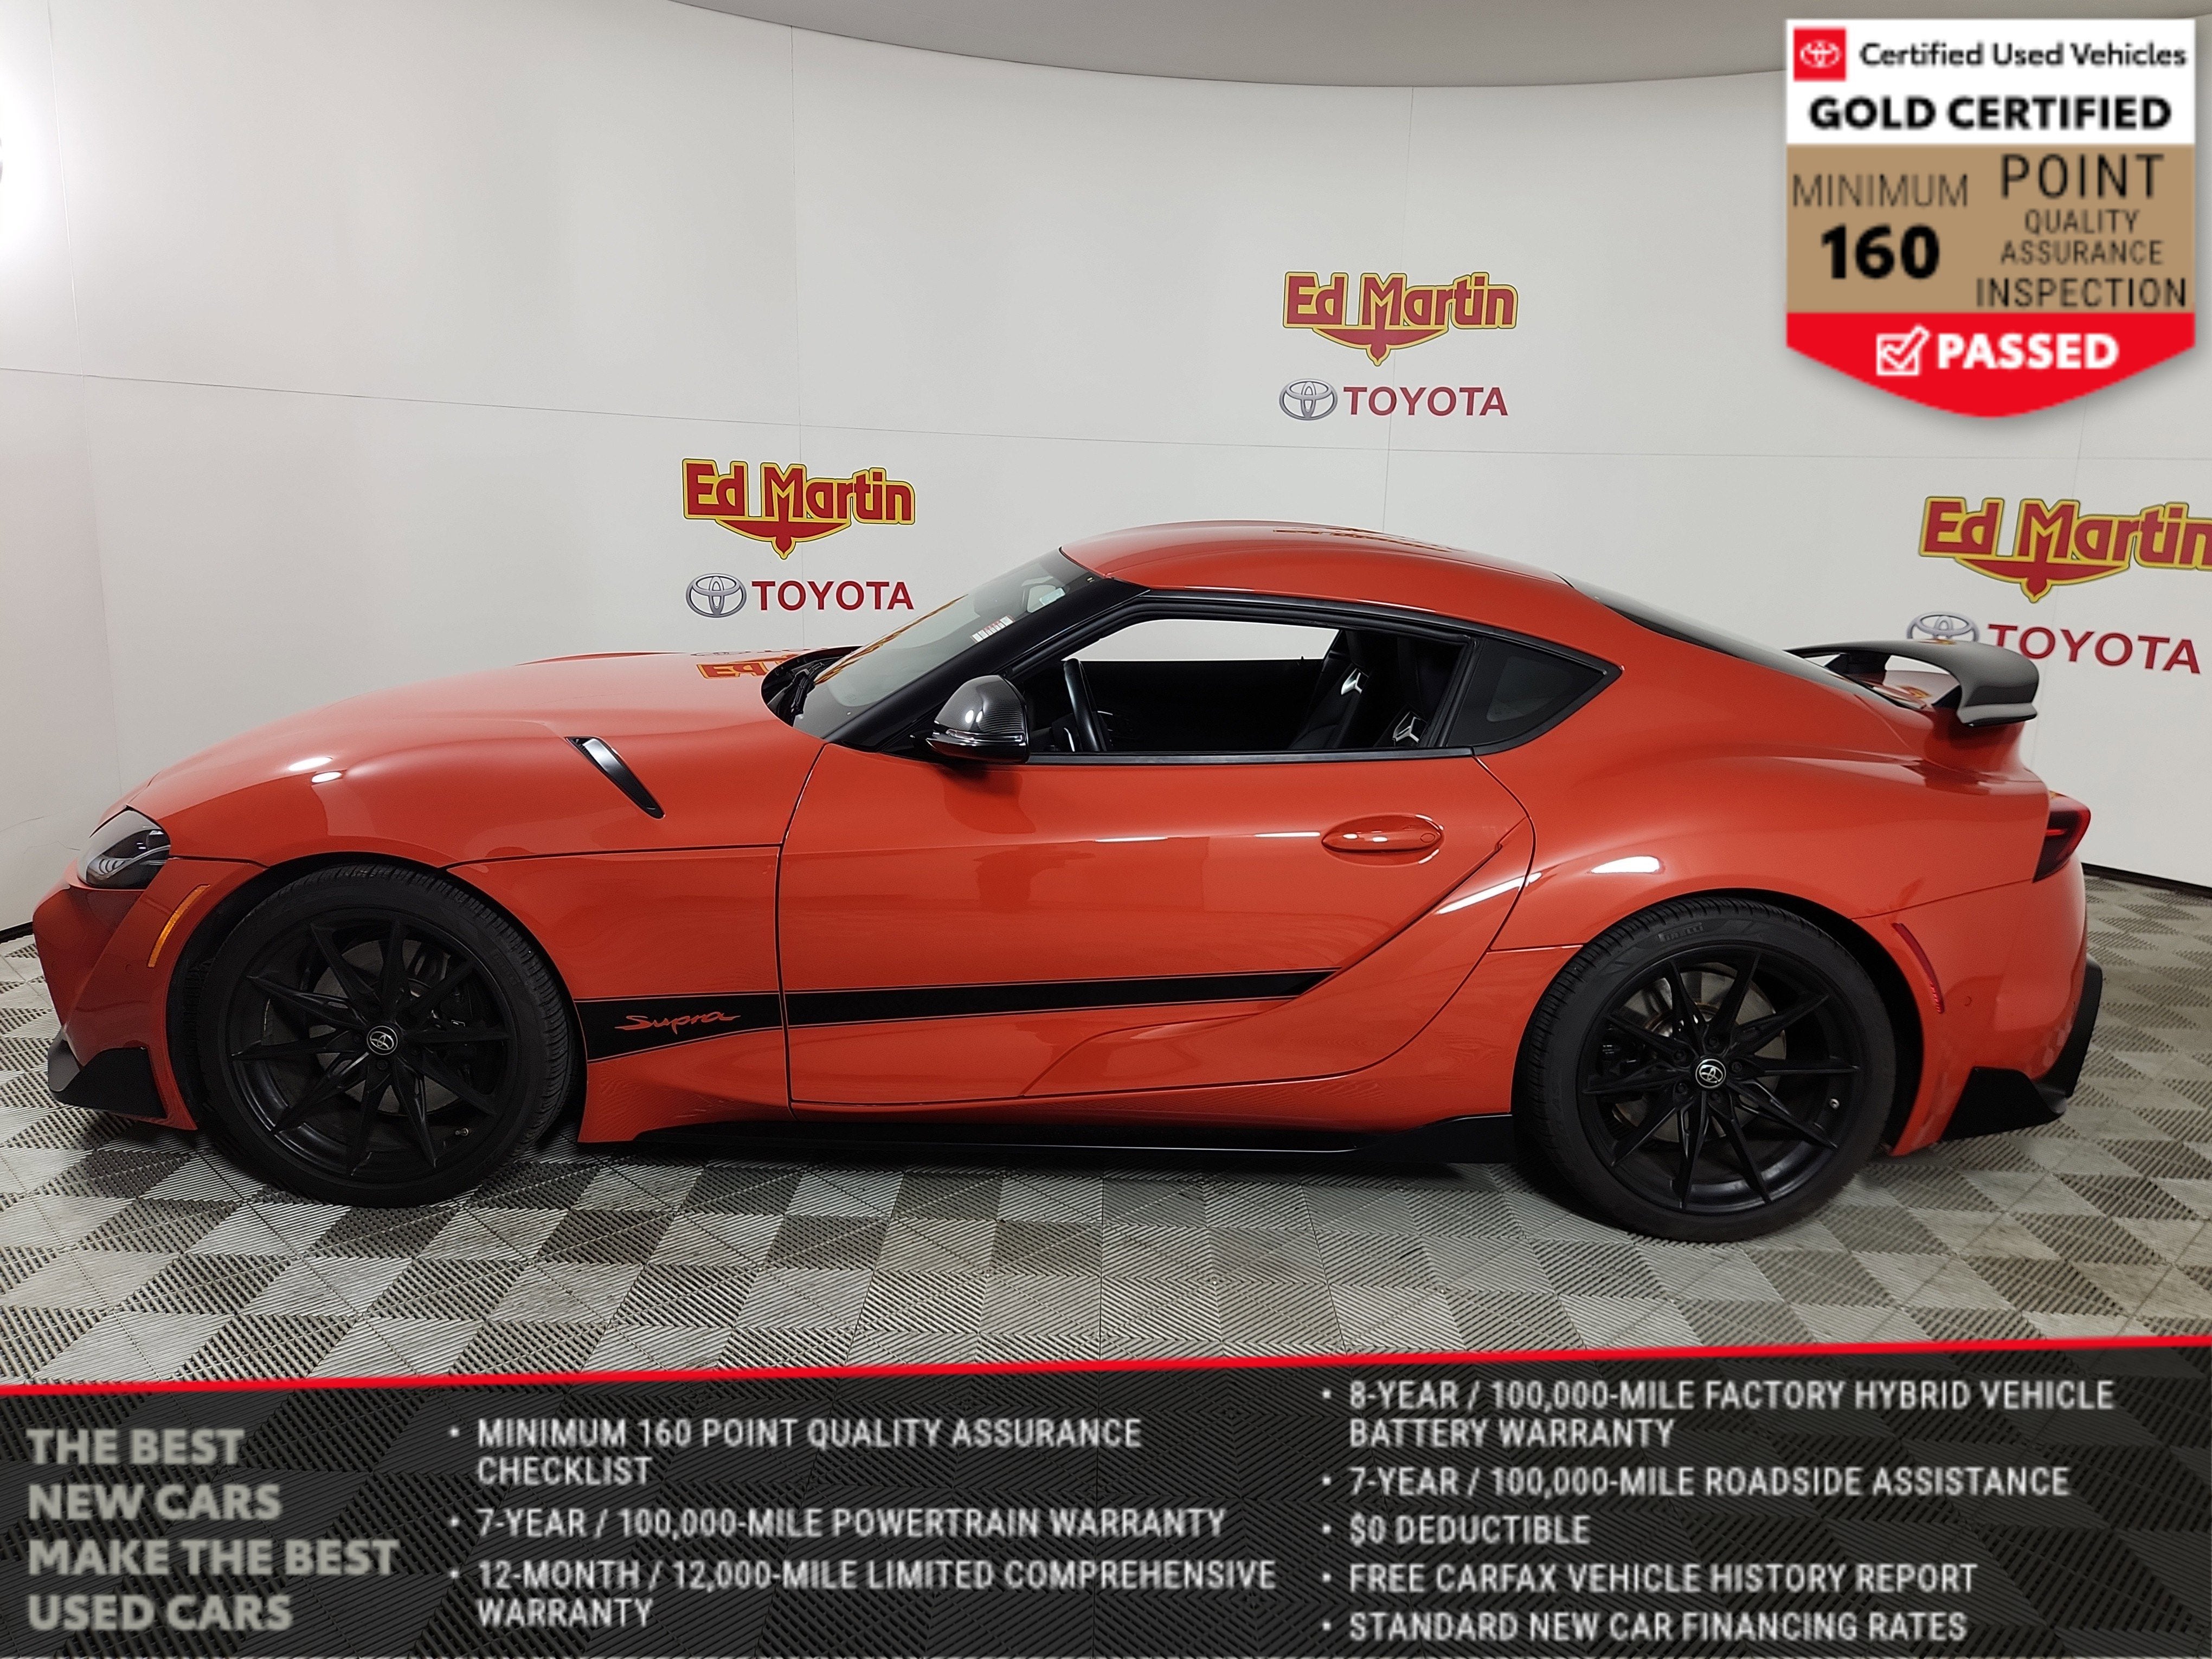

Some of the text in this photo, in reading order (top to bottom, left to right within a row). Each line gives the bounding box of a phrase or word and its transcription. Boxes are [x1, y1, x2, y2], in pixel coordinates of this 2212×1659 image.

[1284, 272, 1518, 329] Ed Martin
[1343, 387, 1508, 416] TOYOTA
[683, 459, 915, 524] Ed Martin
[1919, 496, 2212, 571] Ed Martin
[752, 581, 914, 610] TOYOTA
[1988, 623, 2201, 674] TOYOTA
[614, 1011, 741, 1035] Supra
